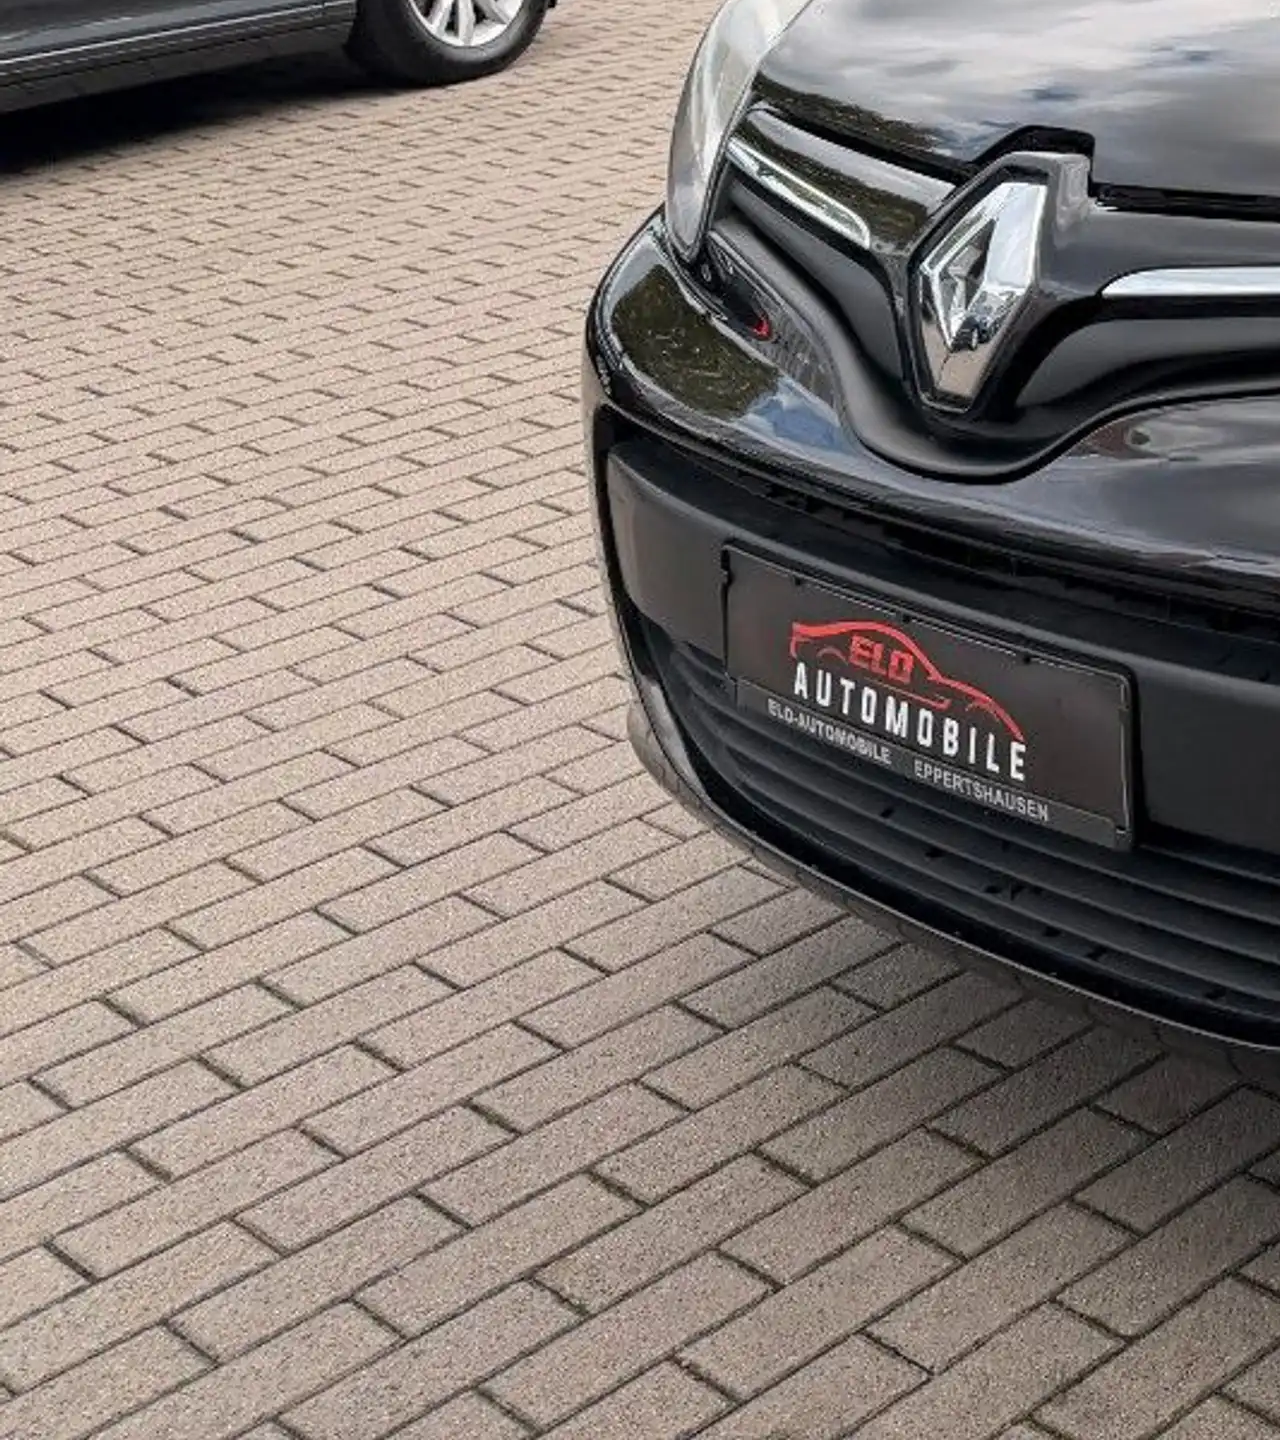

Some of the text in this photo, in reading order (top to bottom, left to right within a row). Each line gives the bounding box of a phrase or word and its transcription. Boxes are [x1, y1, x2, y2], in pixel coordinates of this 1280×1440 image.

[849, 634, 915, 685] ELO
[767, 697, 1050, 823] ELO-AUTOMOBILE EPPERTSHAUSEN
[793, 661, 1027, 782] AUTOMOBILE
